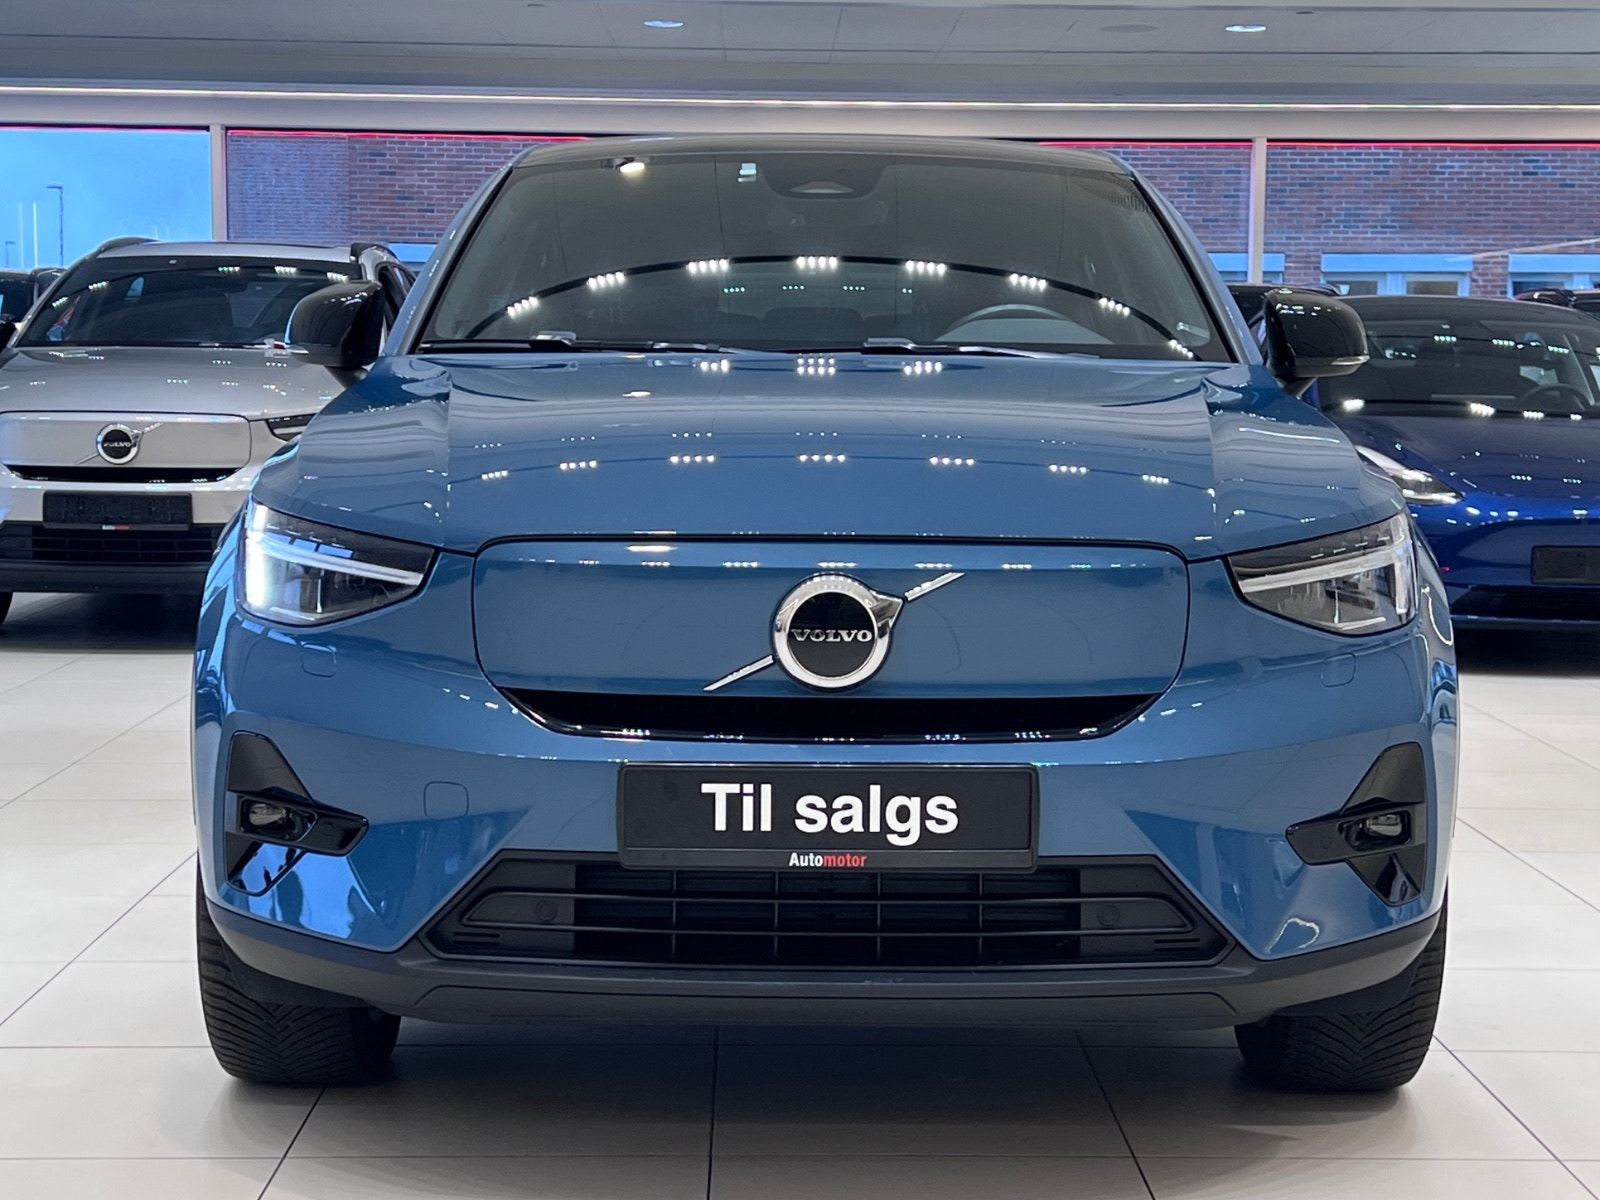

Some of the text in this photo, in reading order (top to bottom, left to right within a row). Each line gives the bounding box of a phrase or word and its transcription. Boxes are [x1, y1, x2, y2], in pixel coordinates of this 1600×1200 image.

[791, 628, 873, 643] VOLVO
[701, 783, 960, 847] Til salgs
[788, 851, 867, 868] Automotor
